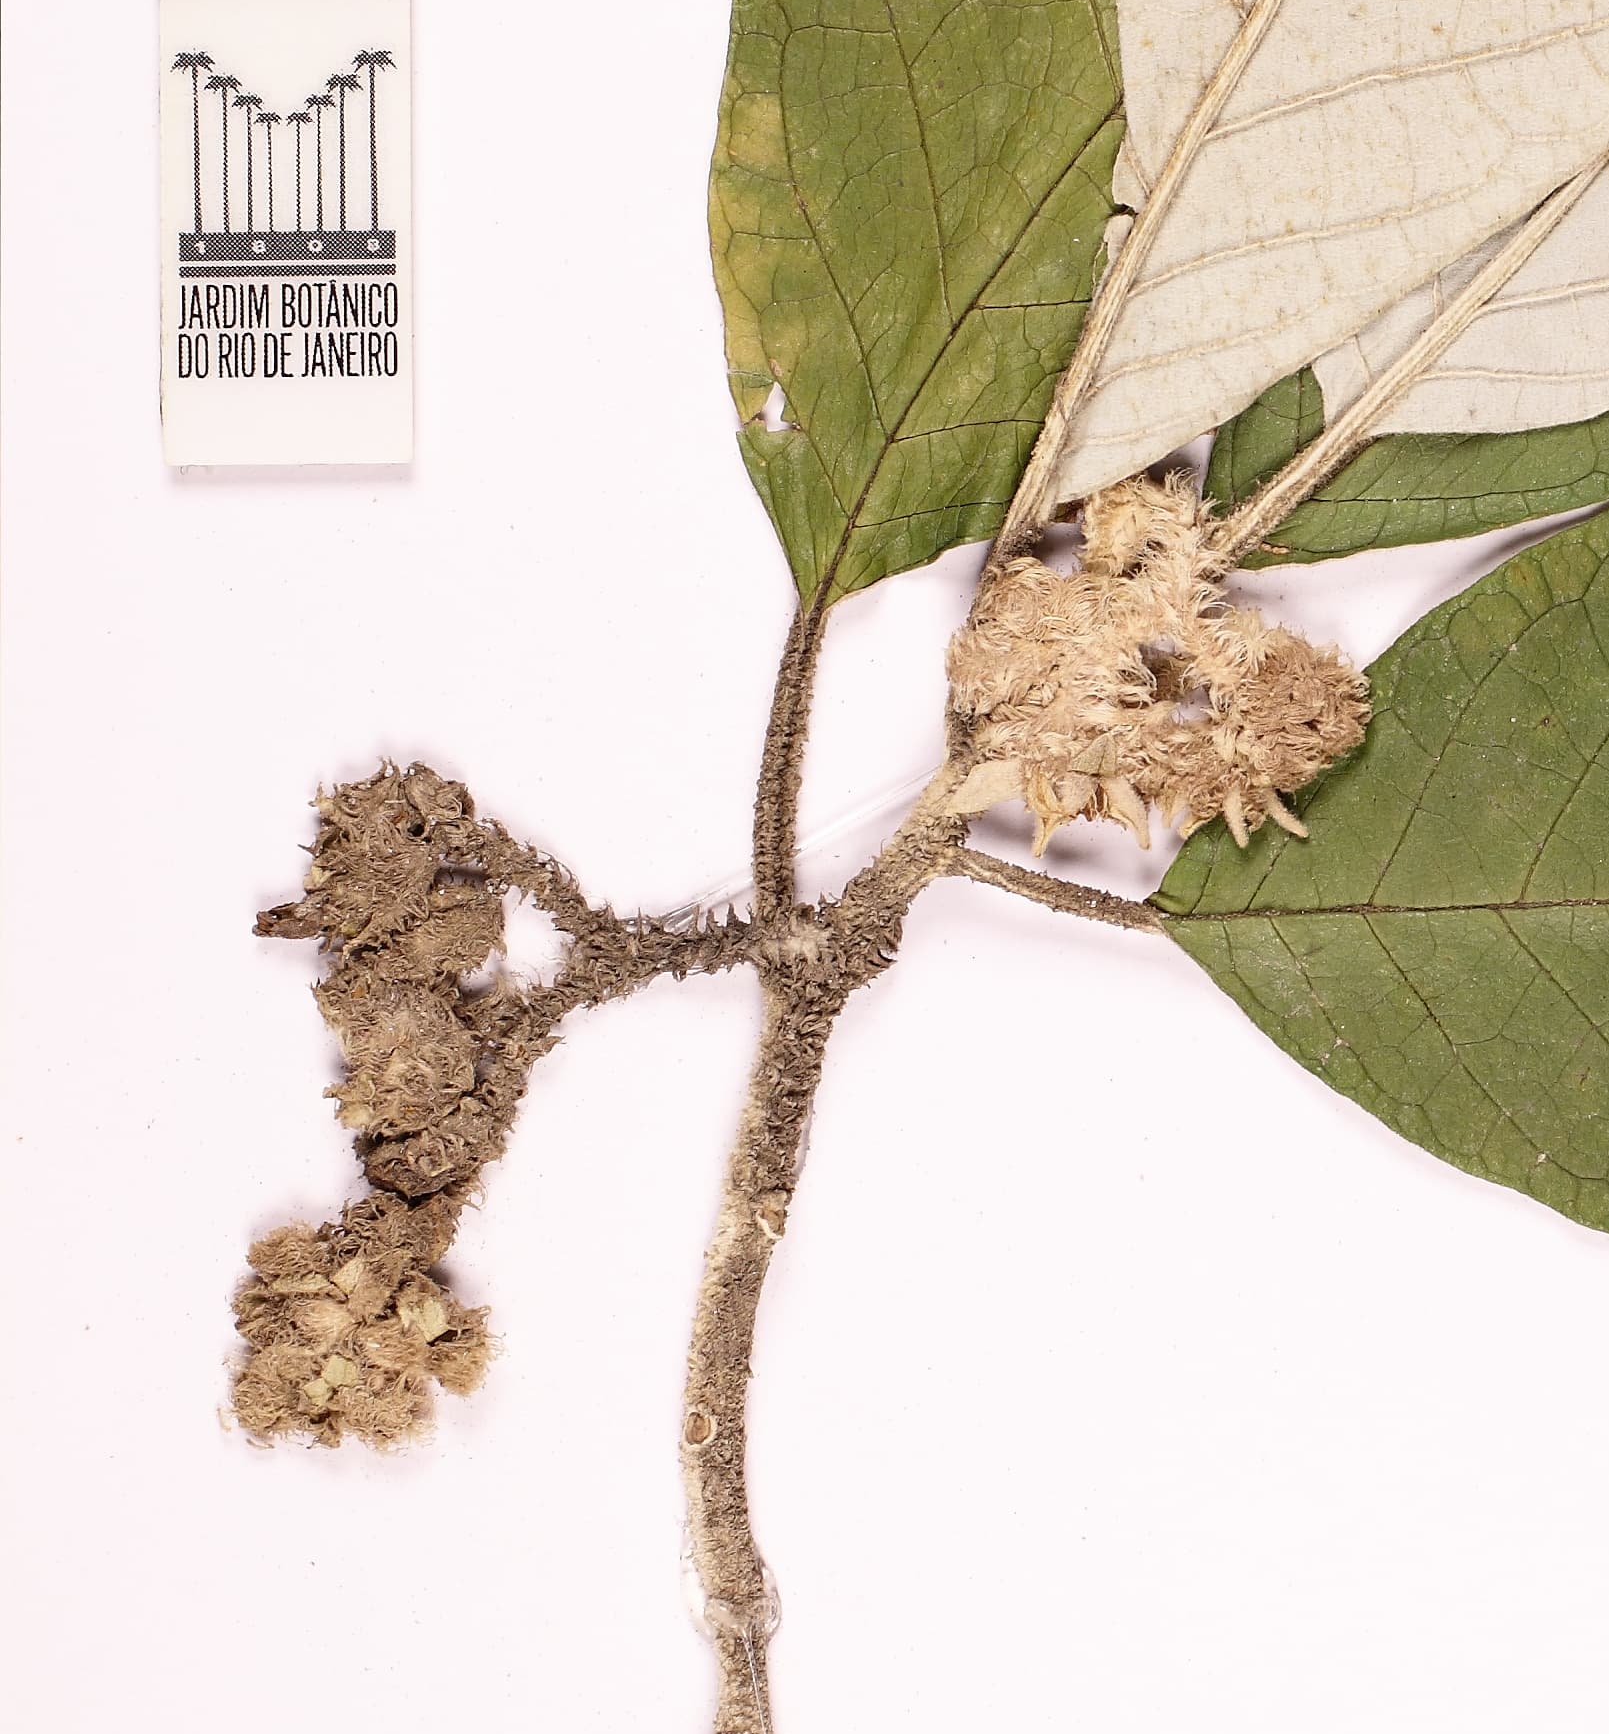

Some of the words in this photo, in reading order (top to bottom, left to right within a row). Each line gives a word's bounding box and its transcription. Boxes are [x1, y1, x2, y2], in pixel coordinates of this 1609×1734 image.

[177, 283, 270, 330] JARDIM
[281, 279, 399, 330] BOTÂNICO
[177, 332, 209, 379] DO
[218, 332, 256, 378] RIO
[263, 332, 294, 378] DE
[301, 331, 399, 378] JANEIRO
